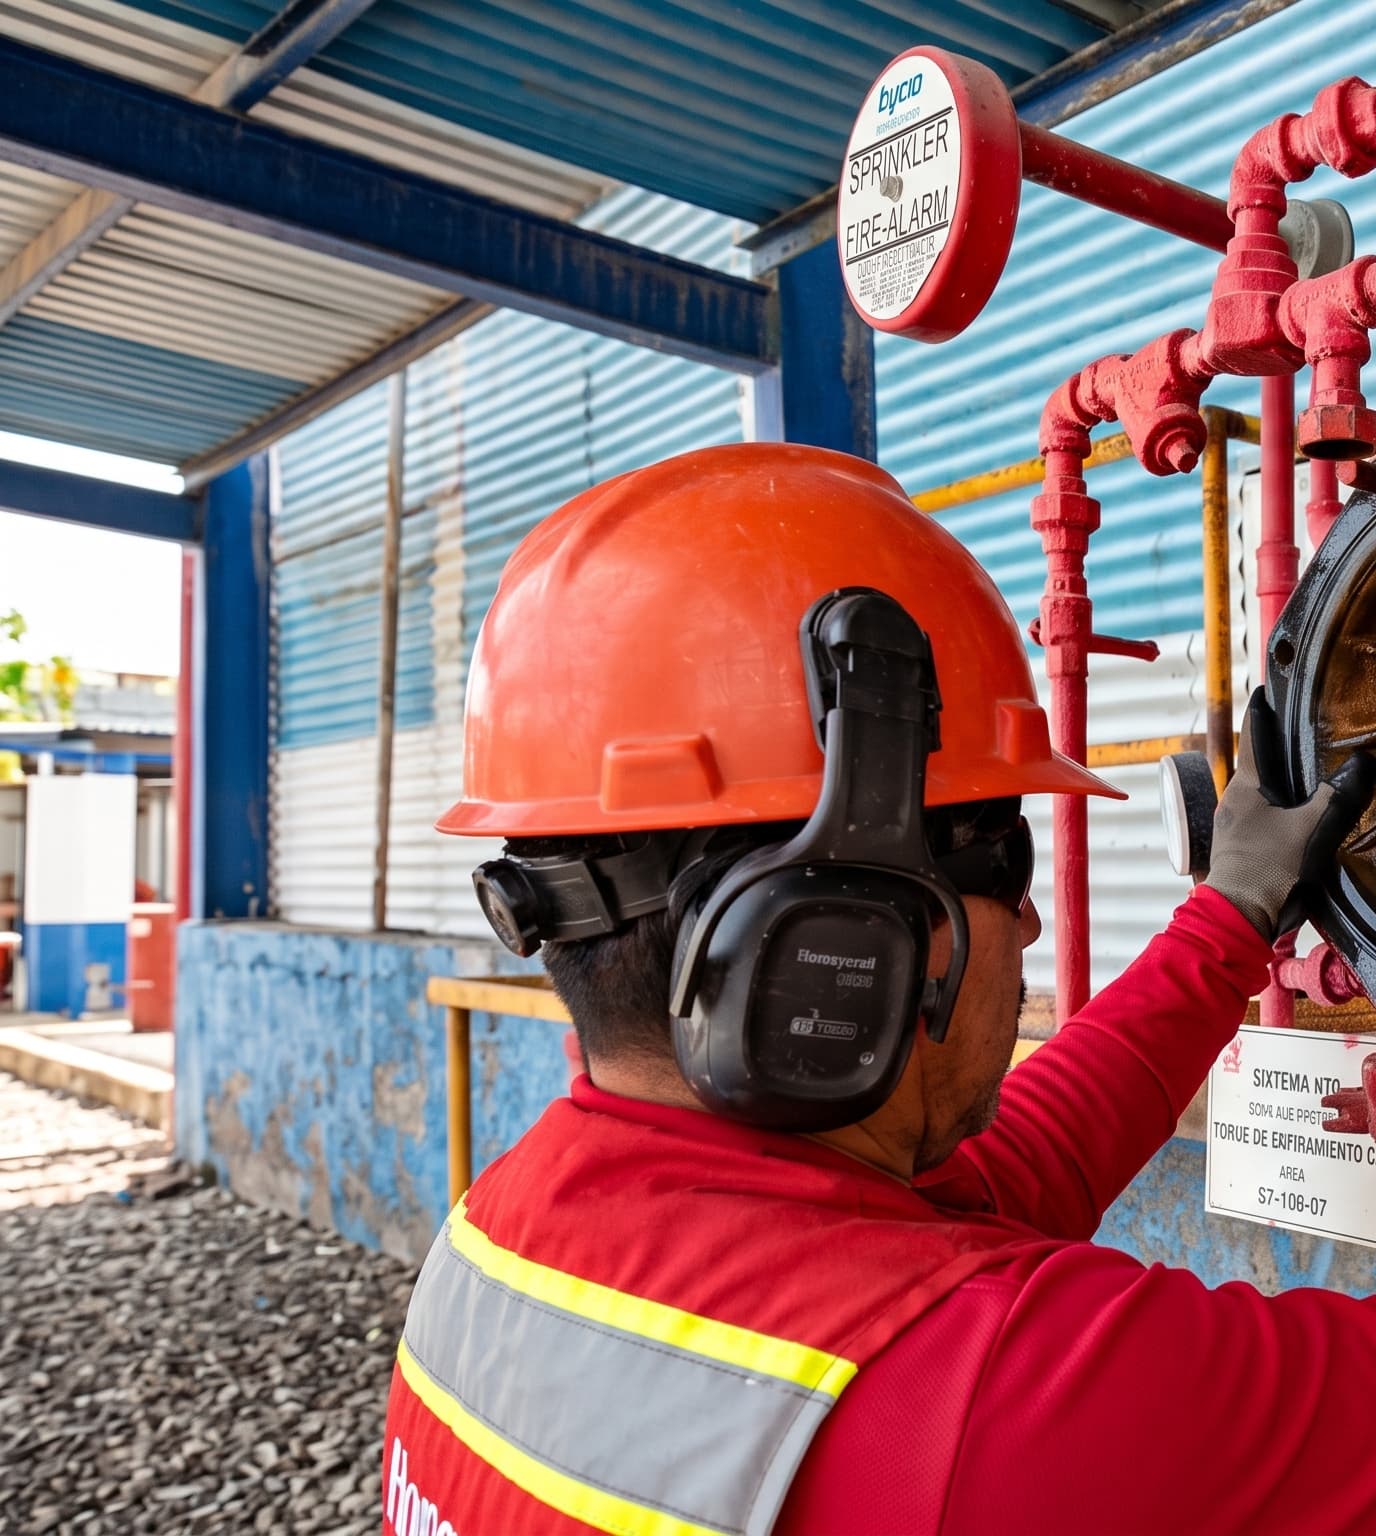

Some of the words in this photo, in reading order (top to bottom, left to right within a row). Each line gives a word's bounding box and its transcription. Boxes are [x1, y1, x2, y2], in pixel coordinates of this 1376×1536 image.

[849, 118, 949, 195] SPRINKLER
[846, 185, 949, 258] FIRE-ALARM
[1253, 1068, 1310, 1093] SIXTEMA
[1276, 1105, 1294, 1121] AUE
[1213, 1121, 1250, 1144] TORUE
[1253, 1128, 1268, 1148] DE
[1279, 1165, 1305, 1183] AREA
